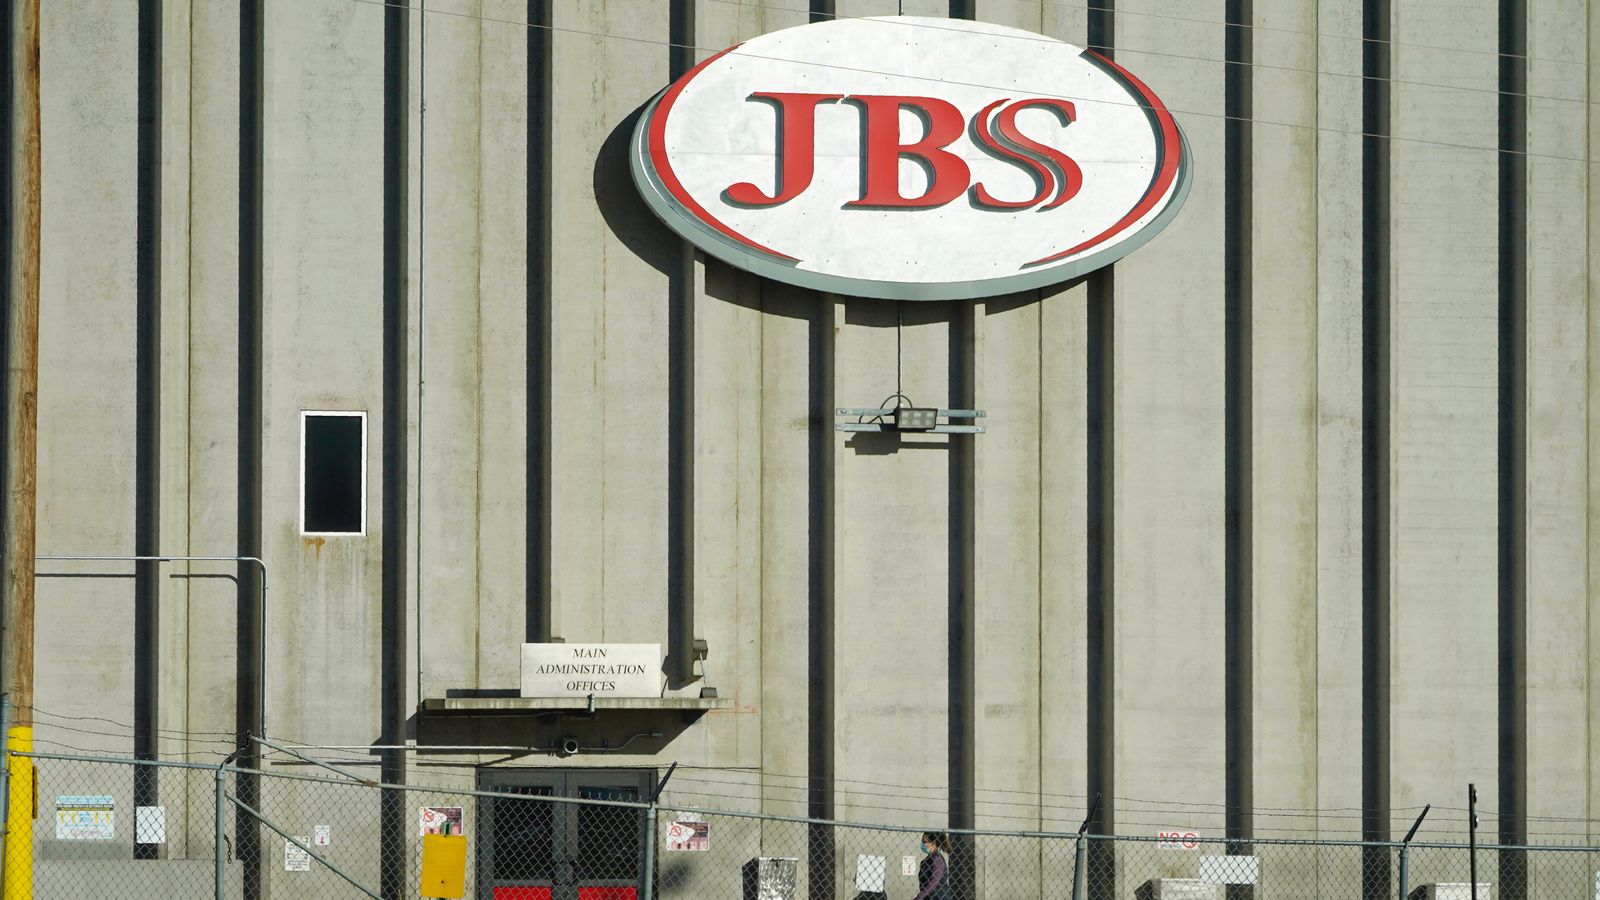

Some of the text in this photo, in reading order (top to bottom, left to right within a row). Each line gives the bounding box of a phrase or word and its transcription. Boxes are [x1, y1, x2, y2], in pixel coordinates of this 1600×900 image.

[722, 91, 1083, 212] JBS
[572, 648, 608, 658] MAIN
[536, 664, 646, 674] ADMINISTRATION
[566, 681, 616, 691] OFFICES
